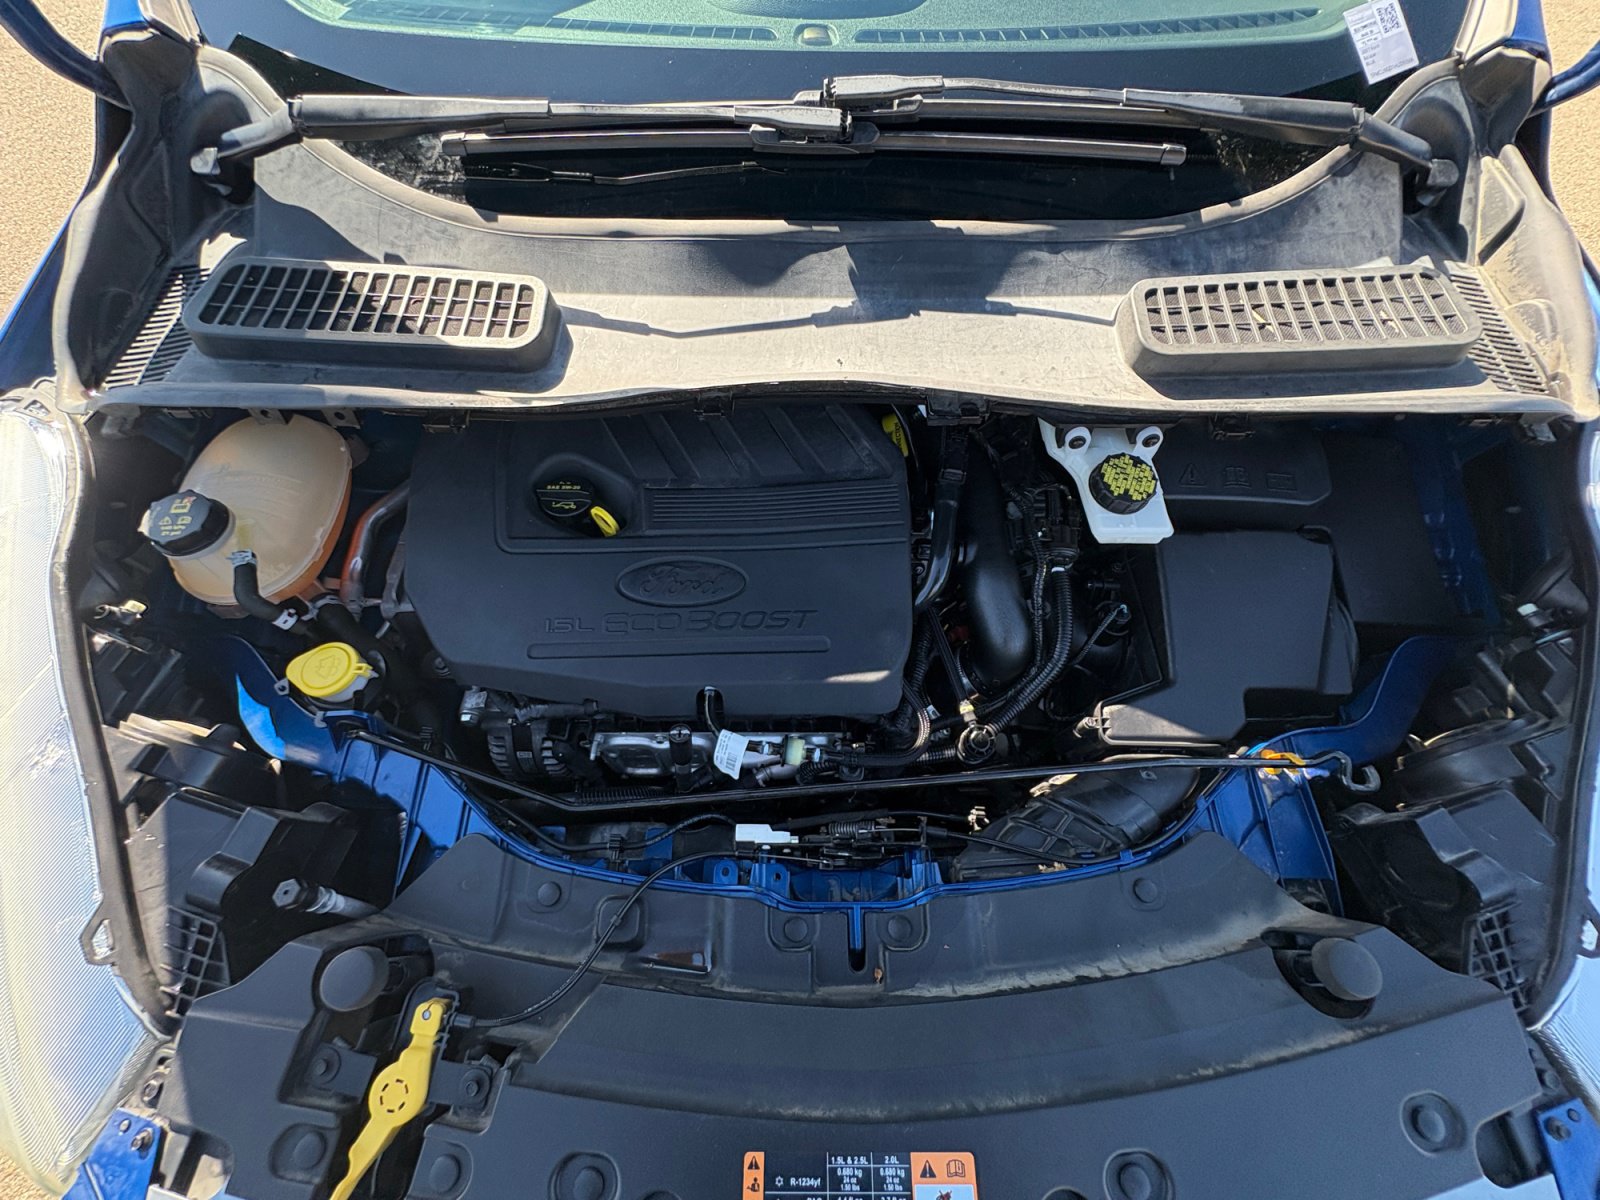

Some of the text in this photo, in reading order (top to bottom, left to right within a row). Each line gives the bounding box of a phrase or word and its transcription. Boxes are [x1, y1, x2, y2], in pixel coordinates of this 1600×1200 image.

[640, 564, 729, 598] Ford
[545, 617, 593, 633] 1.5L
[847, 1156, 852, 1165] &
[884, 1155, 899, 1163] 2.0L
[854, 1167, 862, 1177] kg
[897, 1167, 905, 1177] kg
[790, 1177, 821, 1188] R-1234yf
